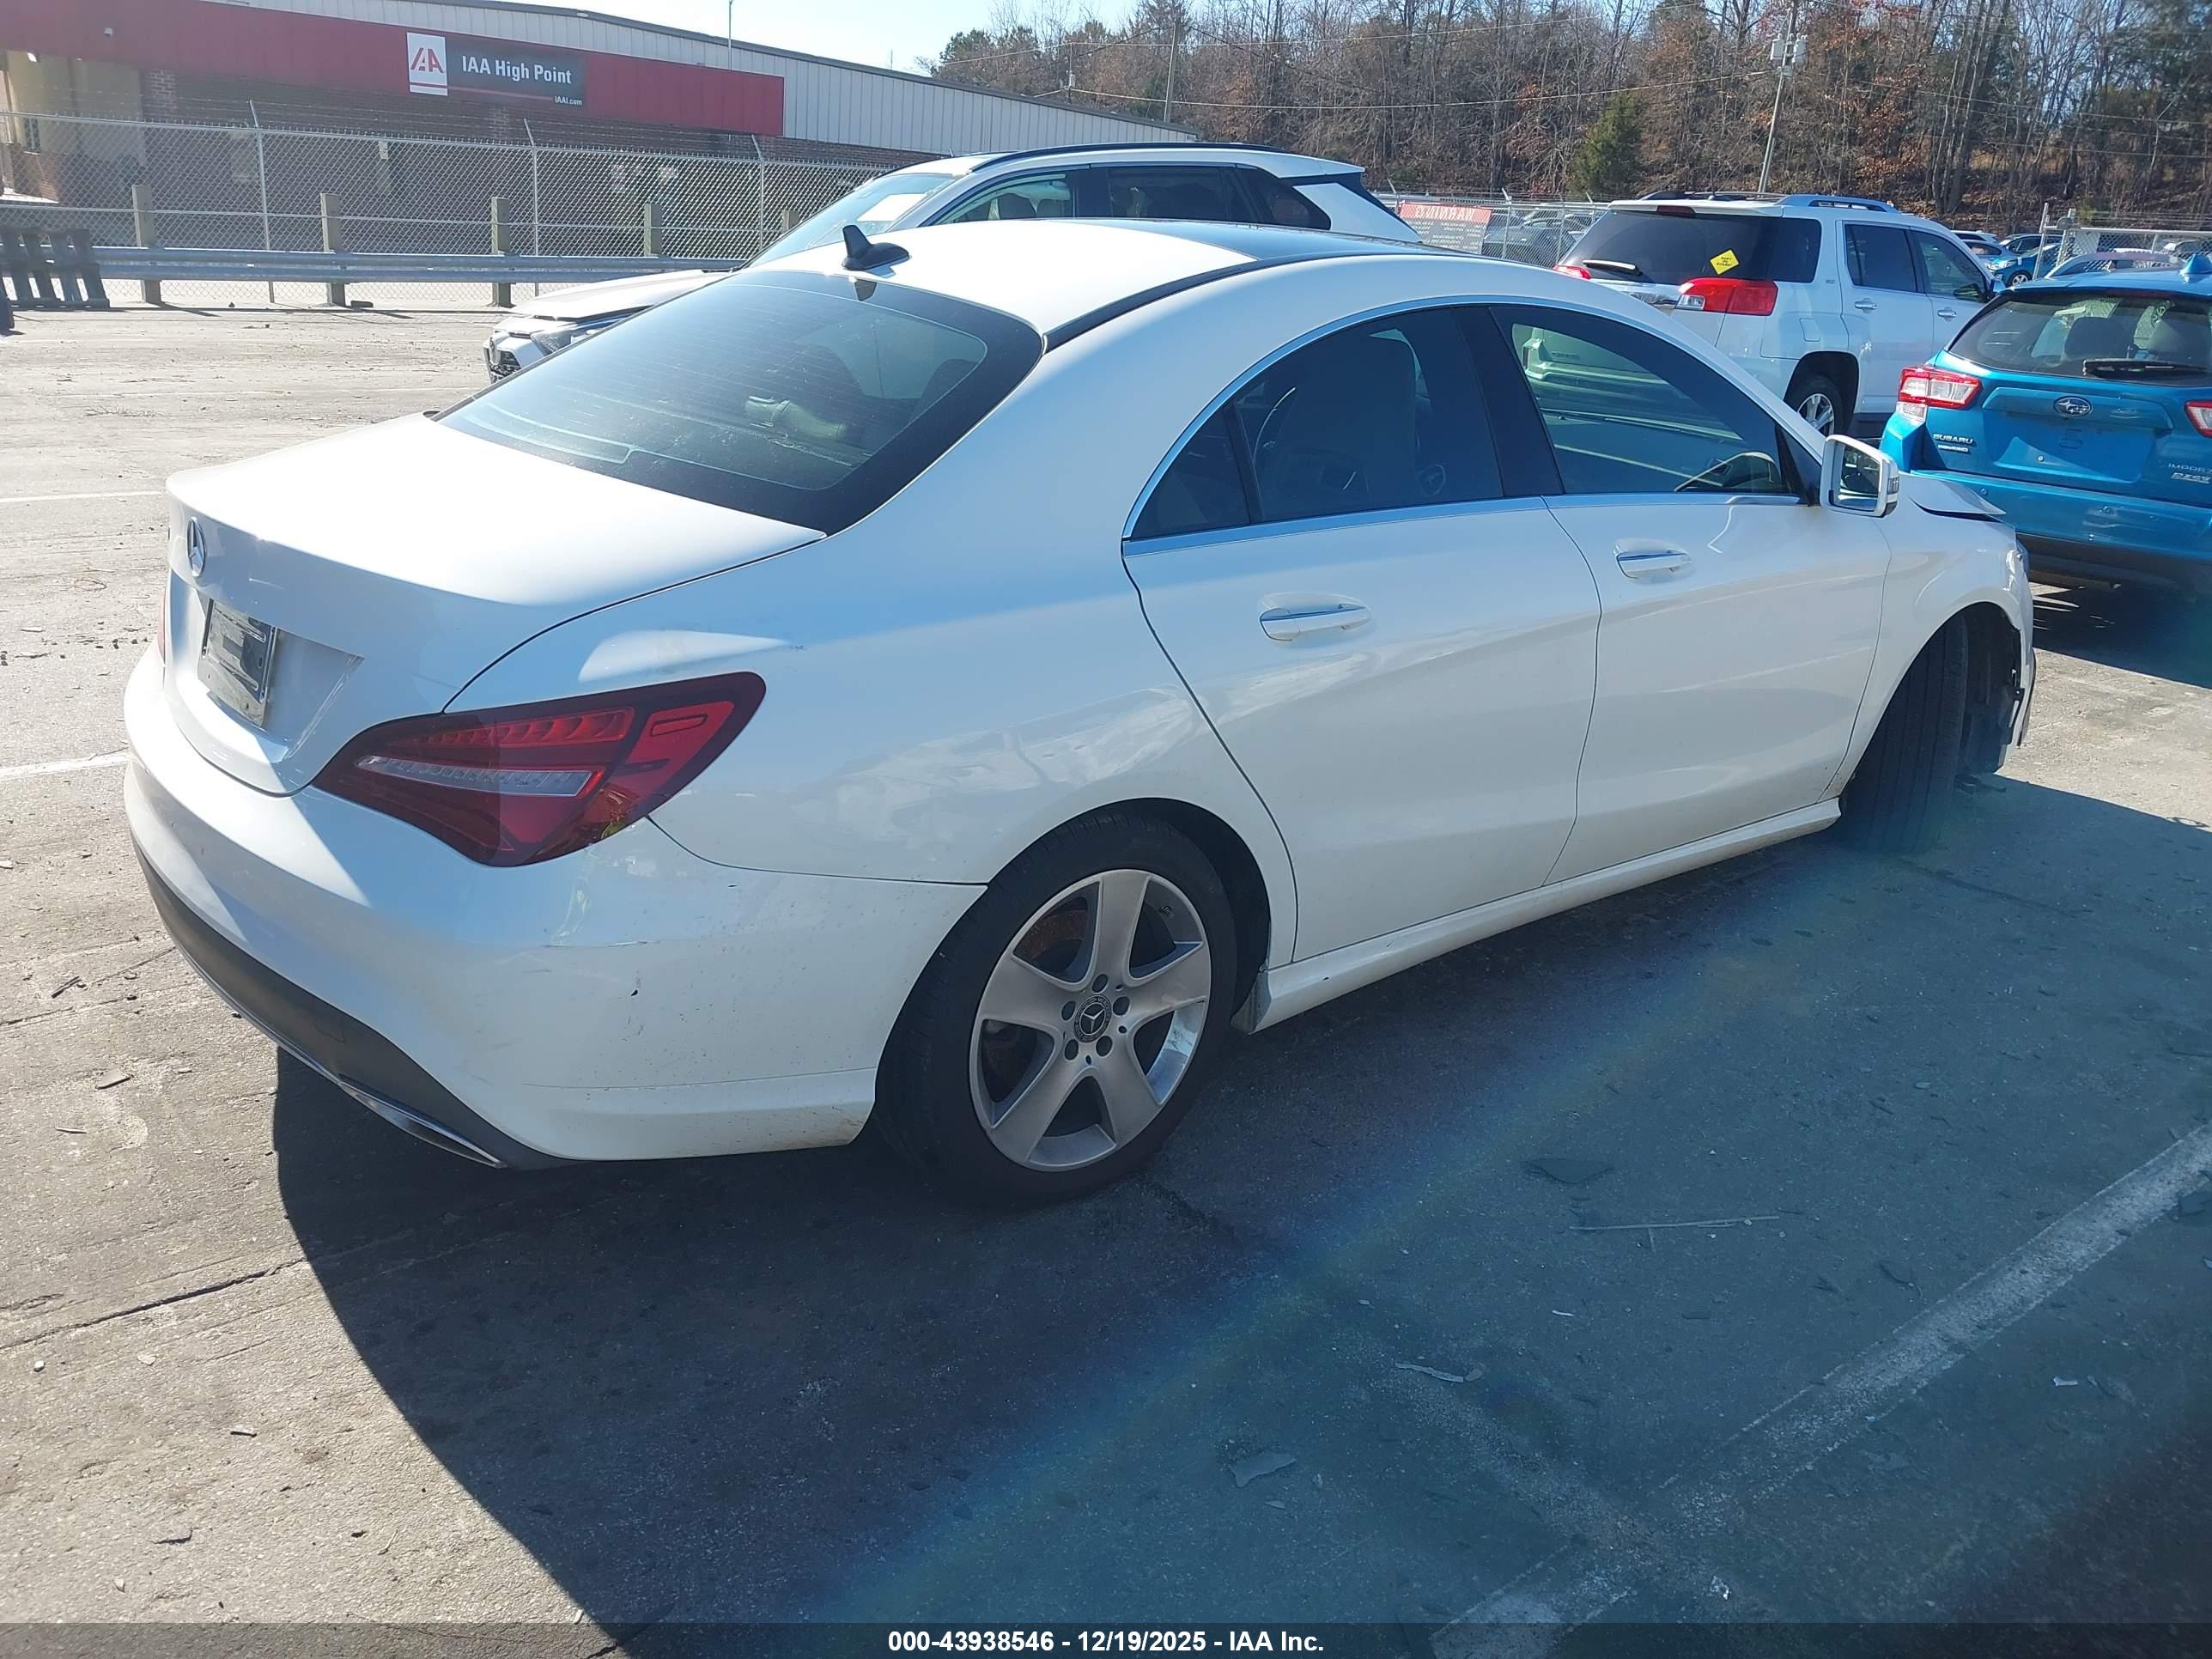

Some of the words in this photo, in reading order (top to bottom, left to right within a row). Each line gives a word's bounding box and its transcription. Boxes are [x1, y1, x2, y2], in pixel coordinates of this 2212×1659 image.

[462, 55, 491, 76] IAA
[495, 59, 530, 82] High
[534, 64, 572, 84] Point
[555, 95, 583, 106] IAAI.com
[1933, 434, 1973, 445] SUBARU
